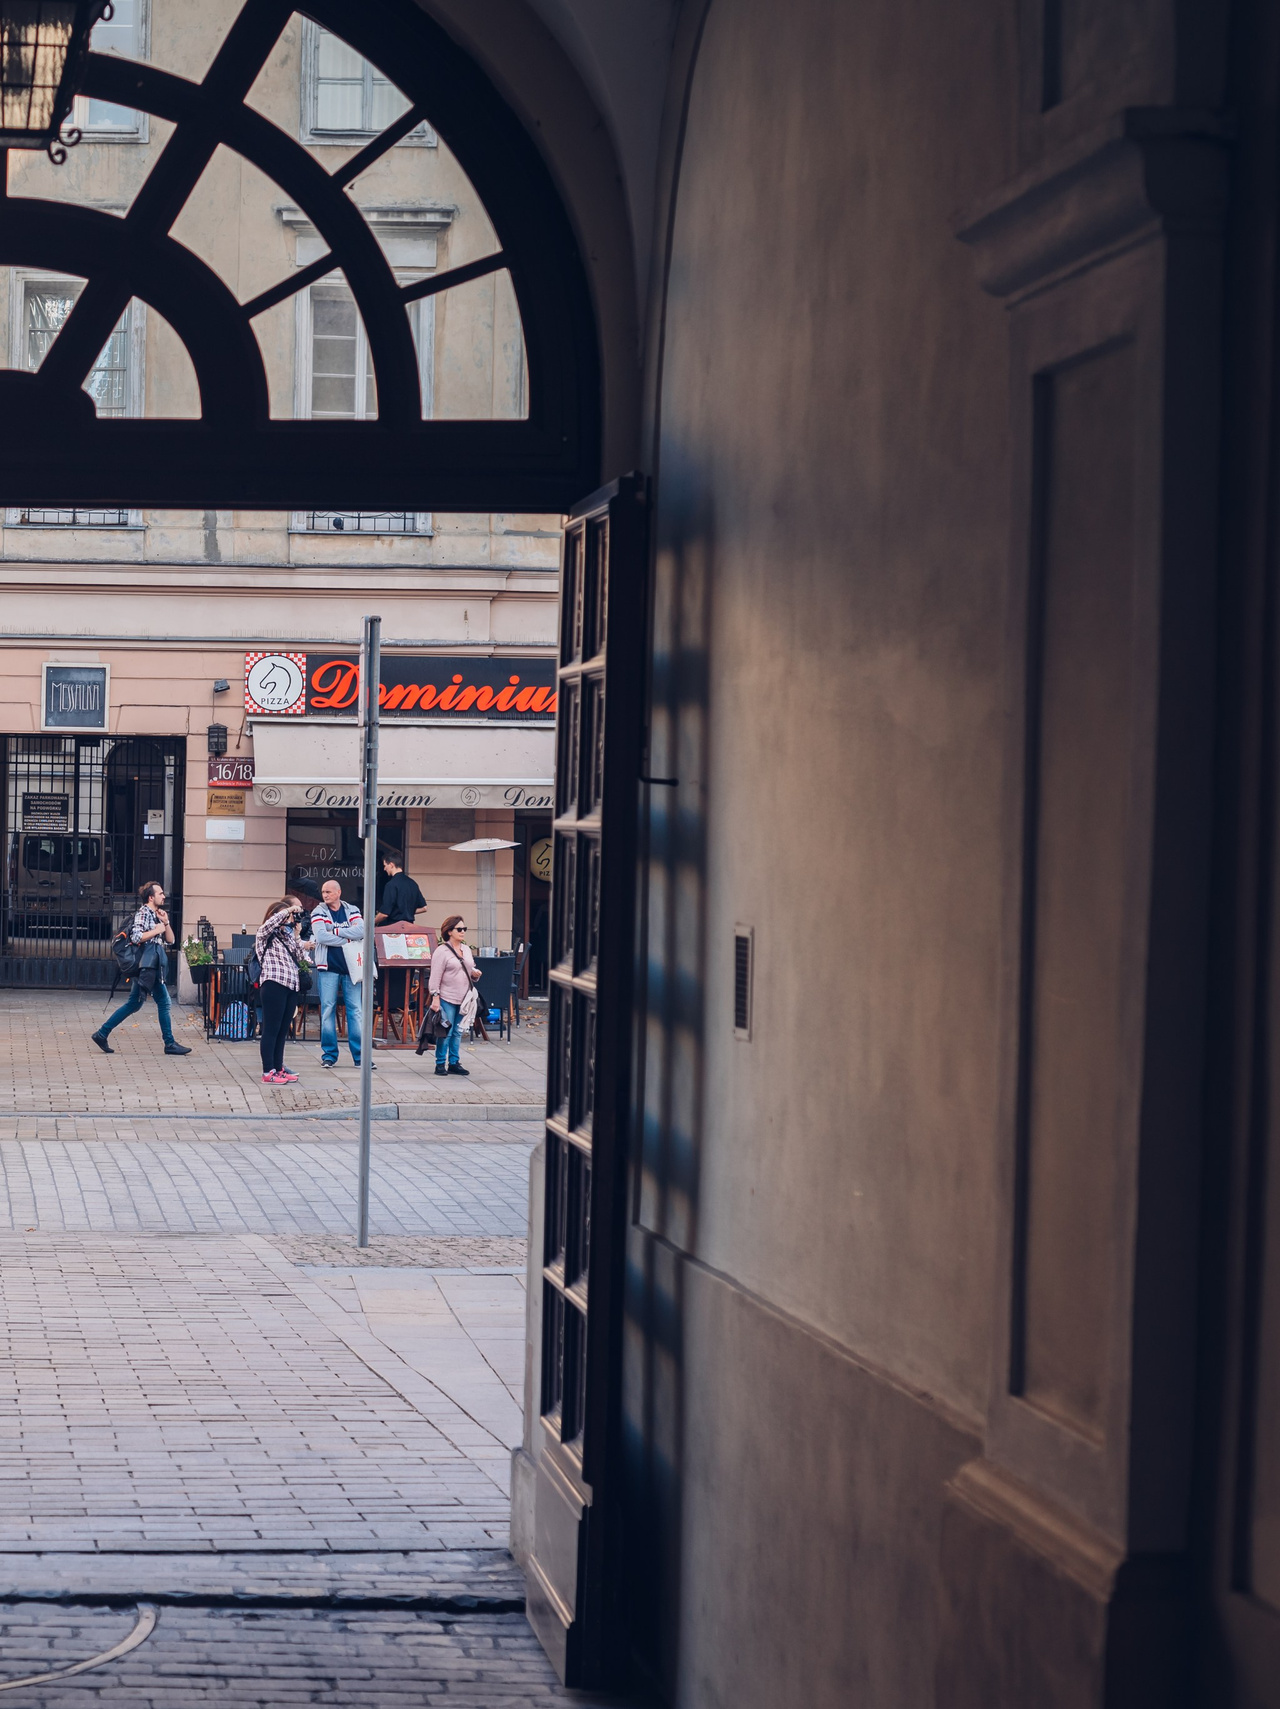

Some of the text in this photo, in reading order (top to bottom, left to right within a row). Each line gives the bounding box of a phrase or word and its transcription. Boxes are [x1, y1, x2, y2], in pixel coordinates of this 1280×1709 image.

[310, 660, 558, 713] Dminiu
[51, 682, 100, 712] MESSALKA
[260, 697, 290, 705] PIZZA
[216, 763, 253, 781] 16/18
[305, 785, 437, 807] Domnium
[298, 866, 319, 879] DLA
